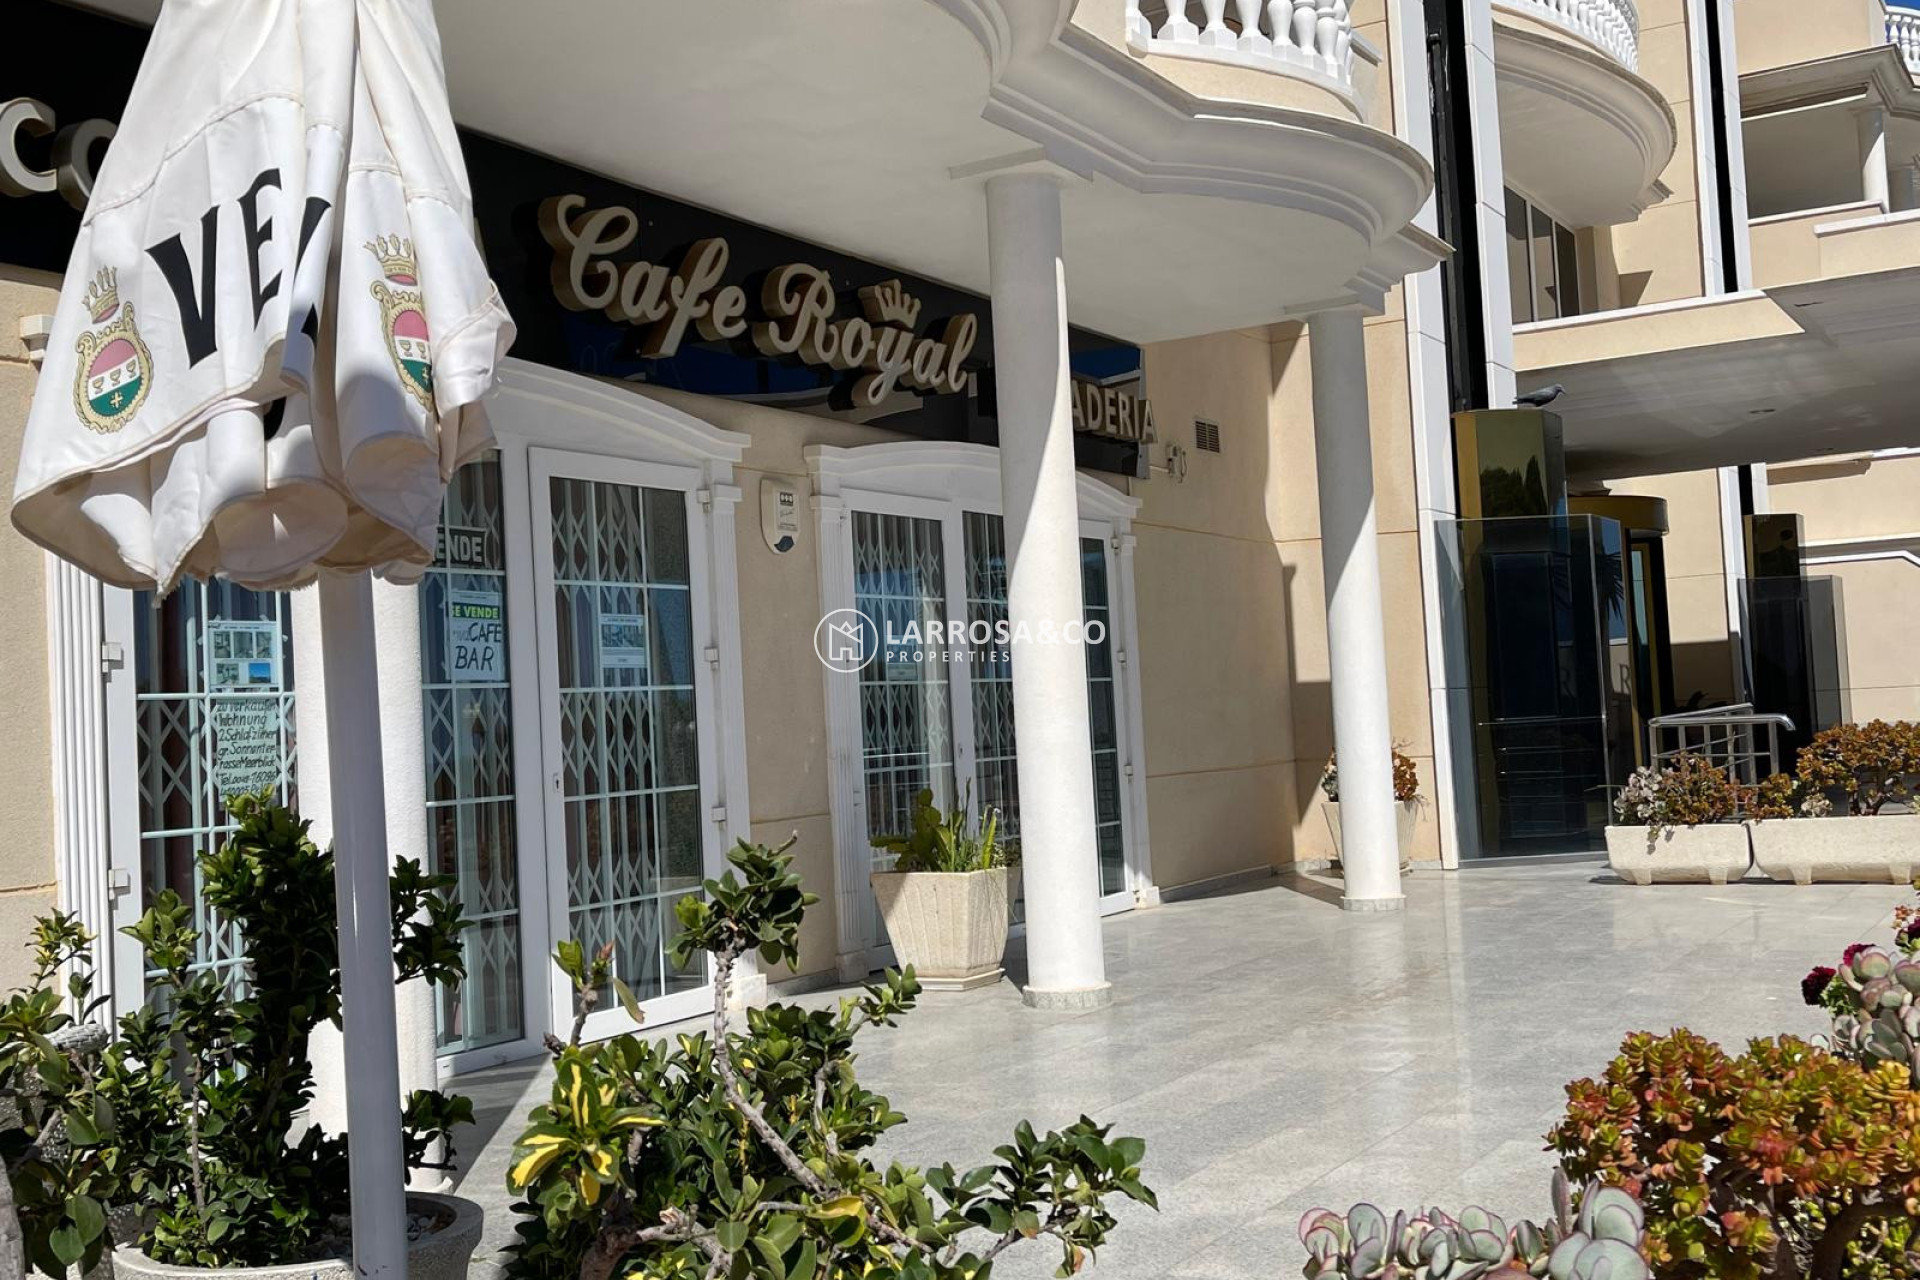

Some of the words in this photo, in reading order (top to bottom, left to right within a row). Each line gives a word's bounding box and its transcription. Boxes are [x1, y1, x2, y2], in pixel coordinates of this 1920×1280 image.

[540, 194, 747, 359] Cafe
[754, 262, 977, 406] Royal
[464, 605, 498, 619] VENDE
[468, 622, 502, 643] CAFE
[455, 645, 494, 671] BAR
